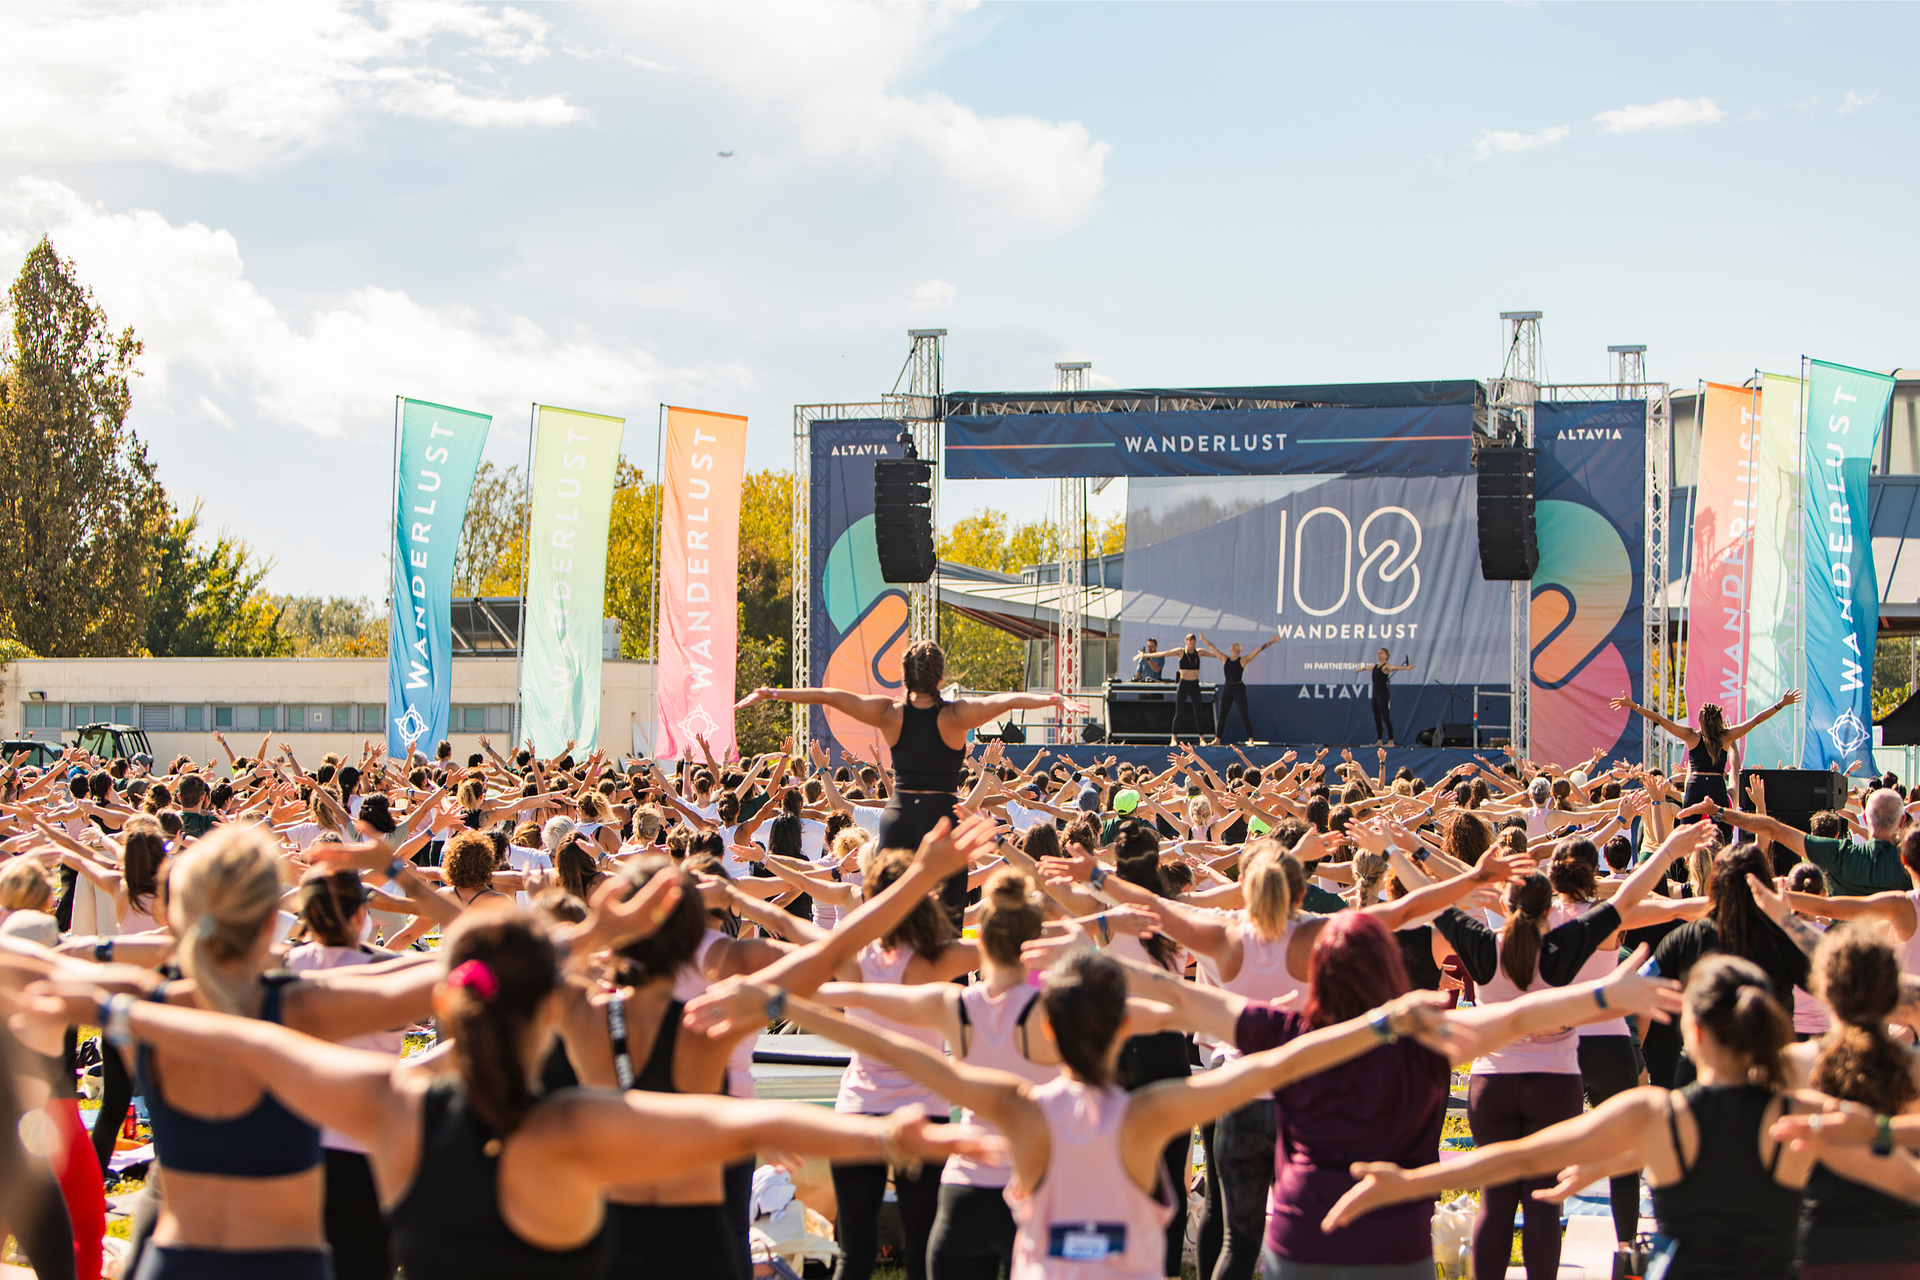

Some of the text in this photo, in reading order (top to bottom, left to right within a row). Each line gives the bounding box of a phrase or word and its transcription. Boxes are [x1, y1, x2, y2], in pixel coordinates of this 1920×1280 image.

[1124, 433, 1287, 453] WANDERLUST
[1557, 428, 1622, 440] ALTAVIA
[831, 444, 888, 456] ALTAVIA
[1826, 385, 1864, 692] WANDERLUST
[405, 421, 455, 690] WANDERLUST
[686, 428, 716, 690] WANDERLUST
[1277, 506, 1422, 617] 108
[1720, 406, 1762, 699] WANDERLUST
[1277, 624, 1418, 639] WANDERLUST
[1304, 662, 1313, 670] IN
[1314, 662, 1365, 670] PARTNERSHIP
[1298, 684, 1373, 698] ALTAVI
